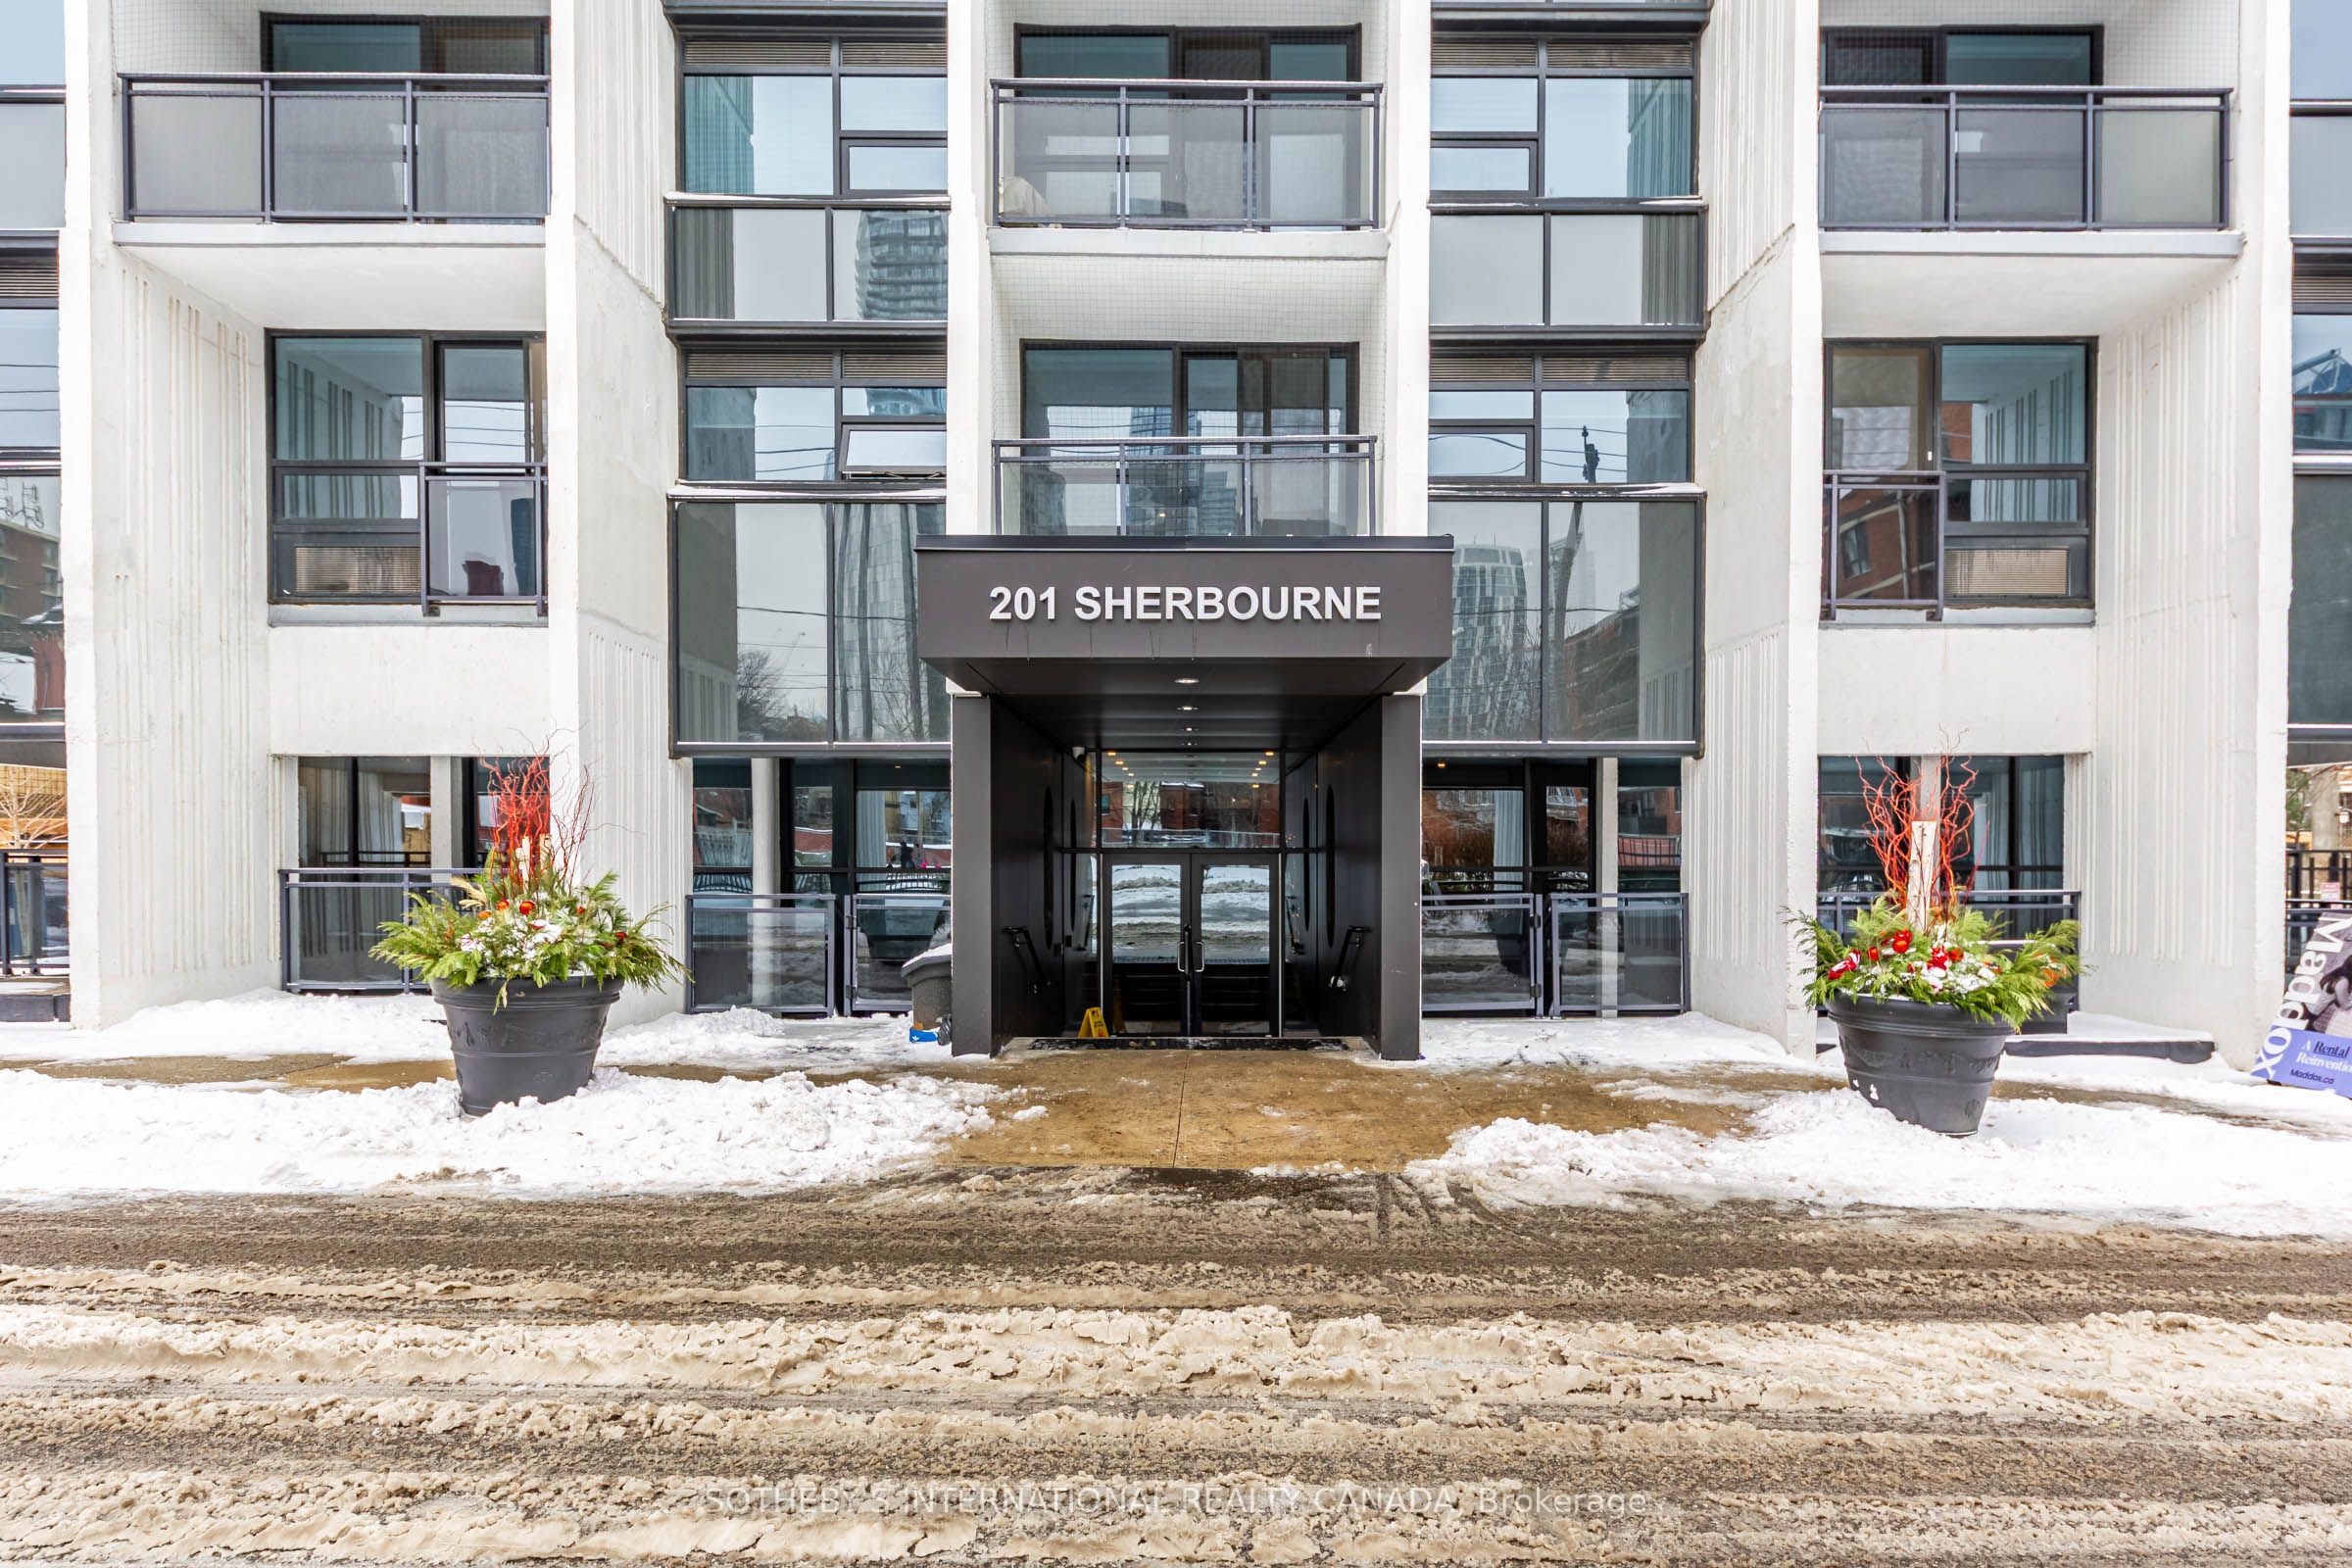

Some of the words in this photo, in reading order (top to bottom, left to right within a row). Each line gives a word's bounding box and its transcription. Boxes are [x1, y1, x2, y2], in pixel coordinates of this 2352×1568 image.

[989, 586, 1056, 621] 201
[1074, 585, 1382, 621] SHERBOURNE
[2250, 916, 2352, 1079] Maddox
[2313, 1041, 2351, 1058] Rental
[2289, 1068, 2335, 1085] Maddox.ca
